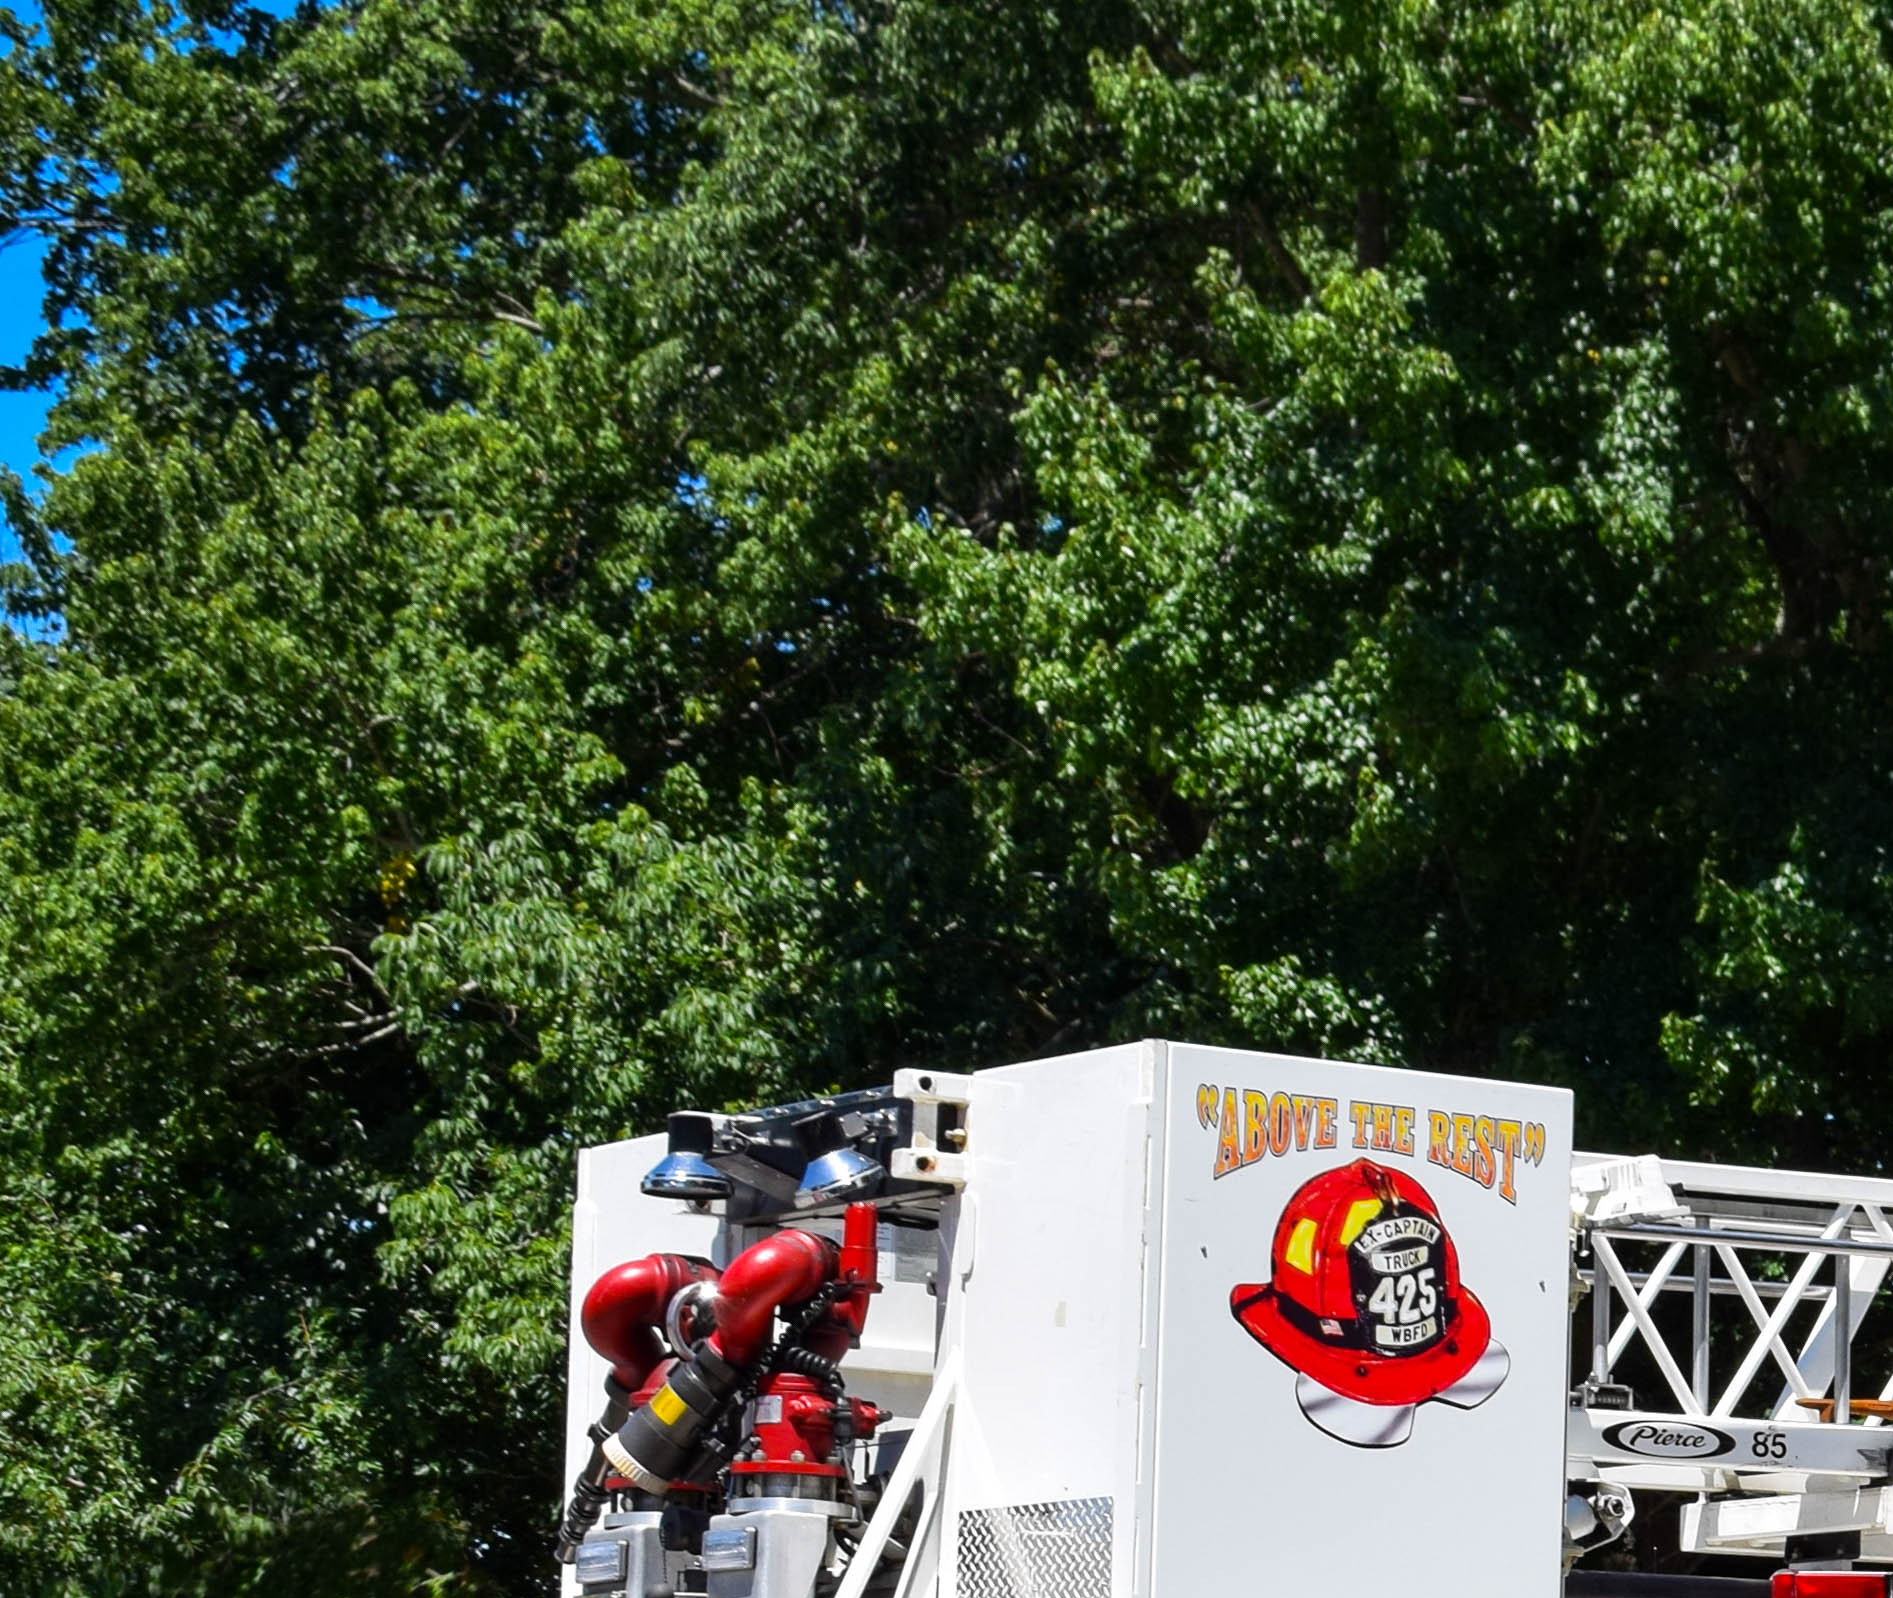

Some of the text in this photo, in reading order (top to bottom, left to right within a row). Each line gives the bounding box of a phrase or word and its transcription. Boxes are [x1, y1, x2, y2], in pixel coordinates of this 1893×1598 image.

[1349, 1100, 1416, 1157] THE
[1360, 1219, 1437, 1250] EX-CAPTAIN
[1384, 1251, 1421, 1270] TRUCK
[1368, 1267, 1437, 1325] 425
[1391, 1323, 1428, 1342] WBFD
[1629, 1425, 1707, 1449] Pierce
[1751, 1431, 1788, 1460] 85
